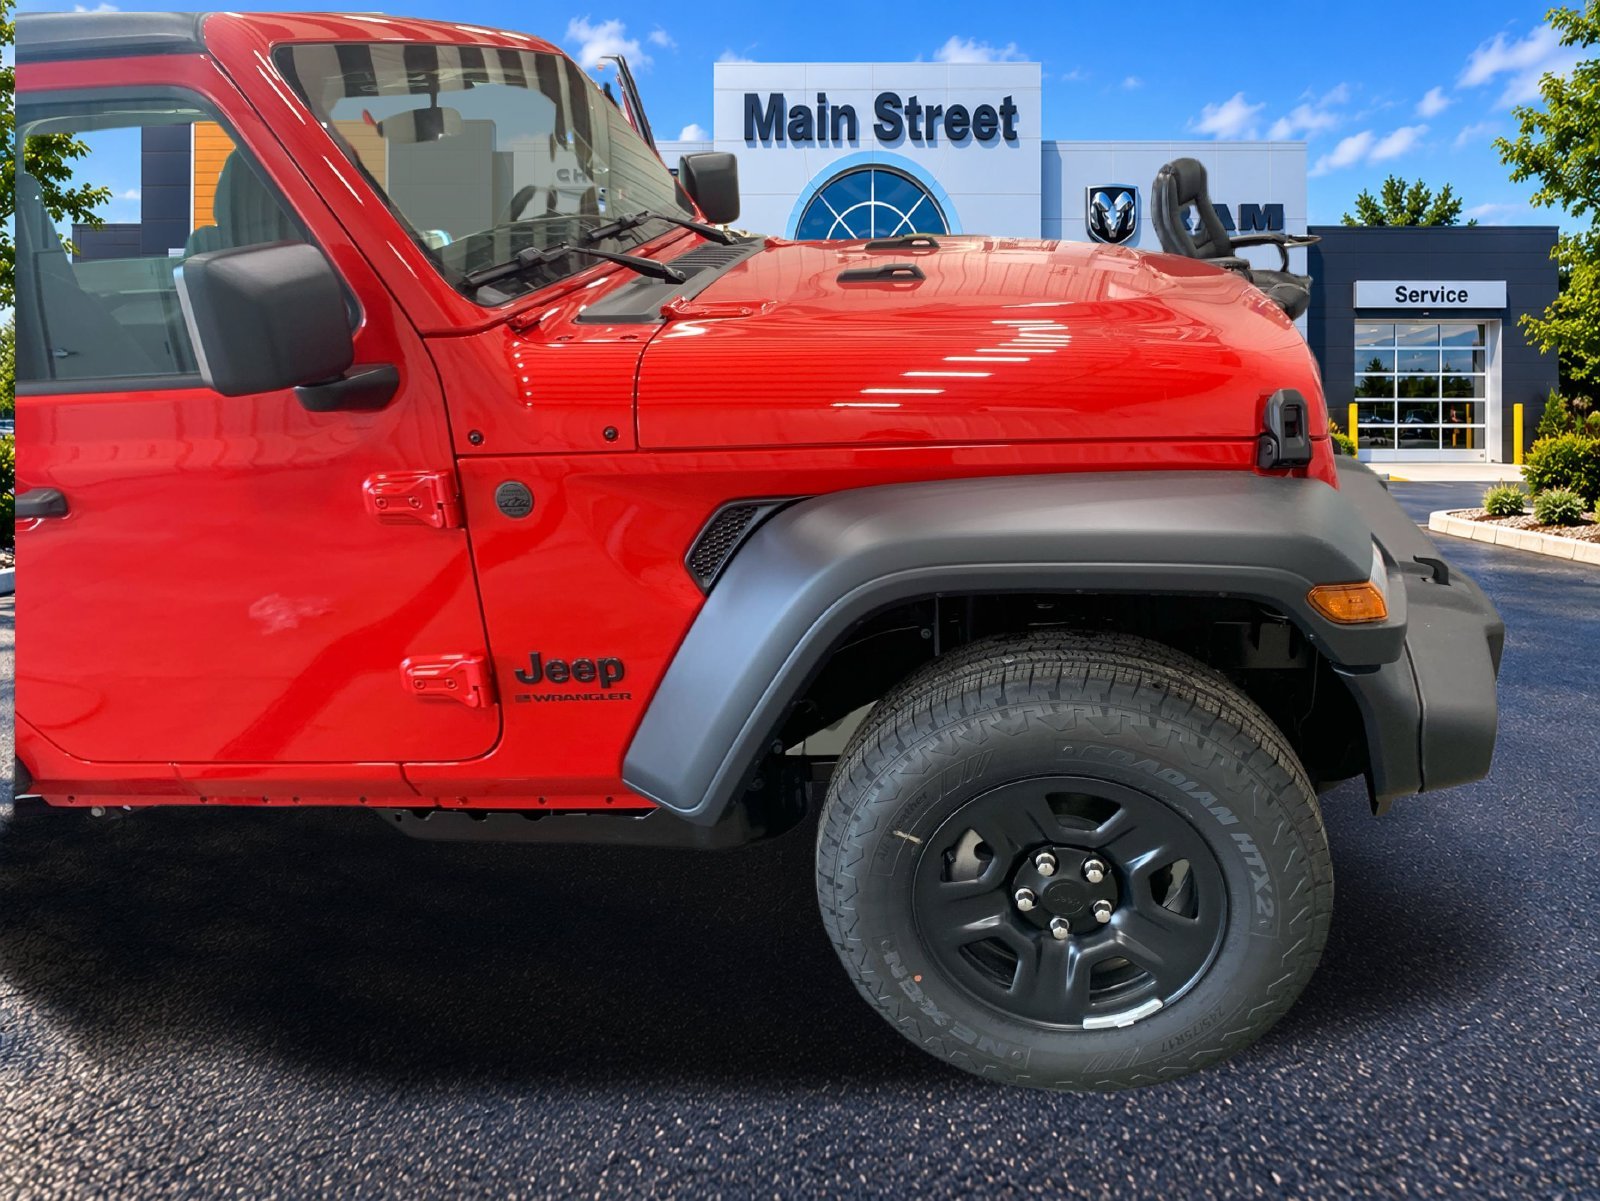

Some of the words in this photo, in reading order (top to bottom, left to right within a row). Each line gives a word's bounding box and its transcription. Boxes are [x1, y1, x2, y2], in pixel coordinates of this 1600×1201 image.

[743, 92, 857, 143] Main
[873, 92, 1018, 143] Street
[1395, 286, 1468, 303] Service
[514, 652, 624, 688] Jeep
[532, 692, 632, 702] WRANGLER
